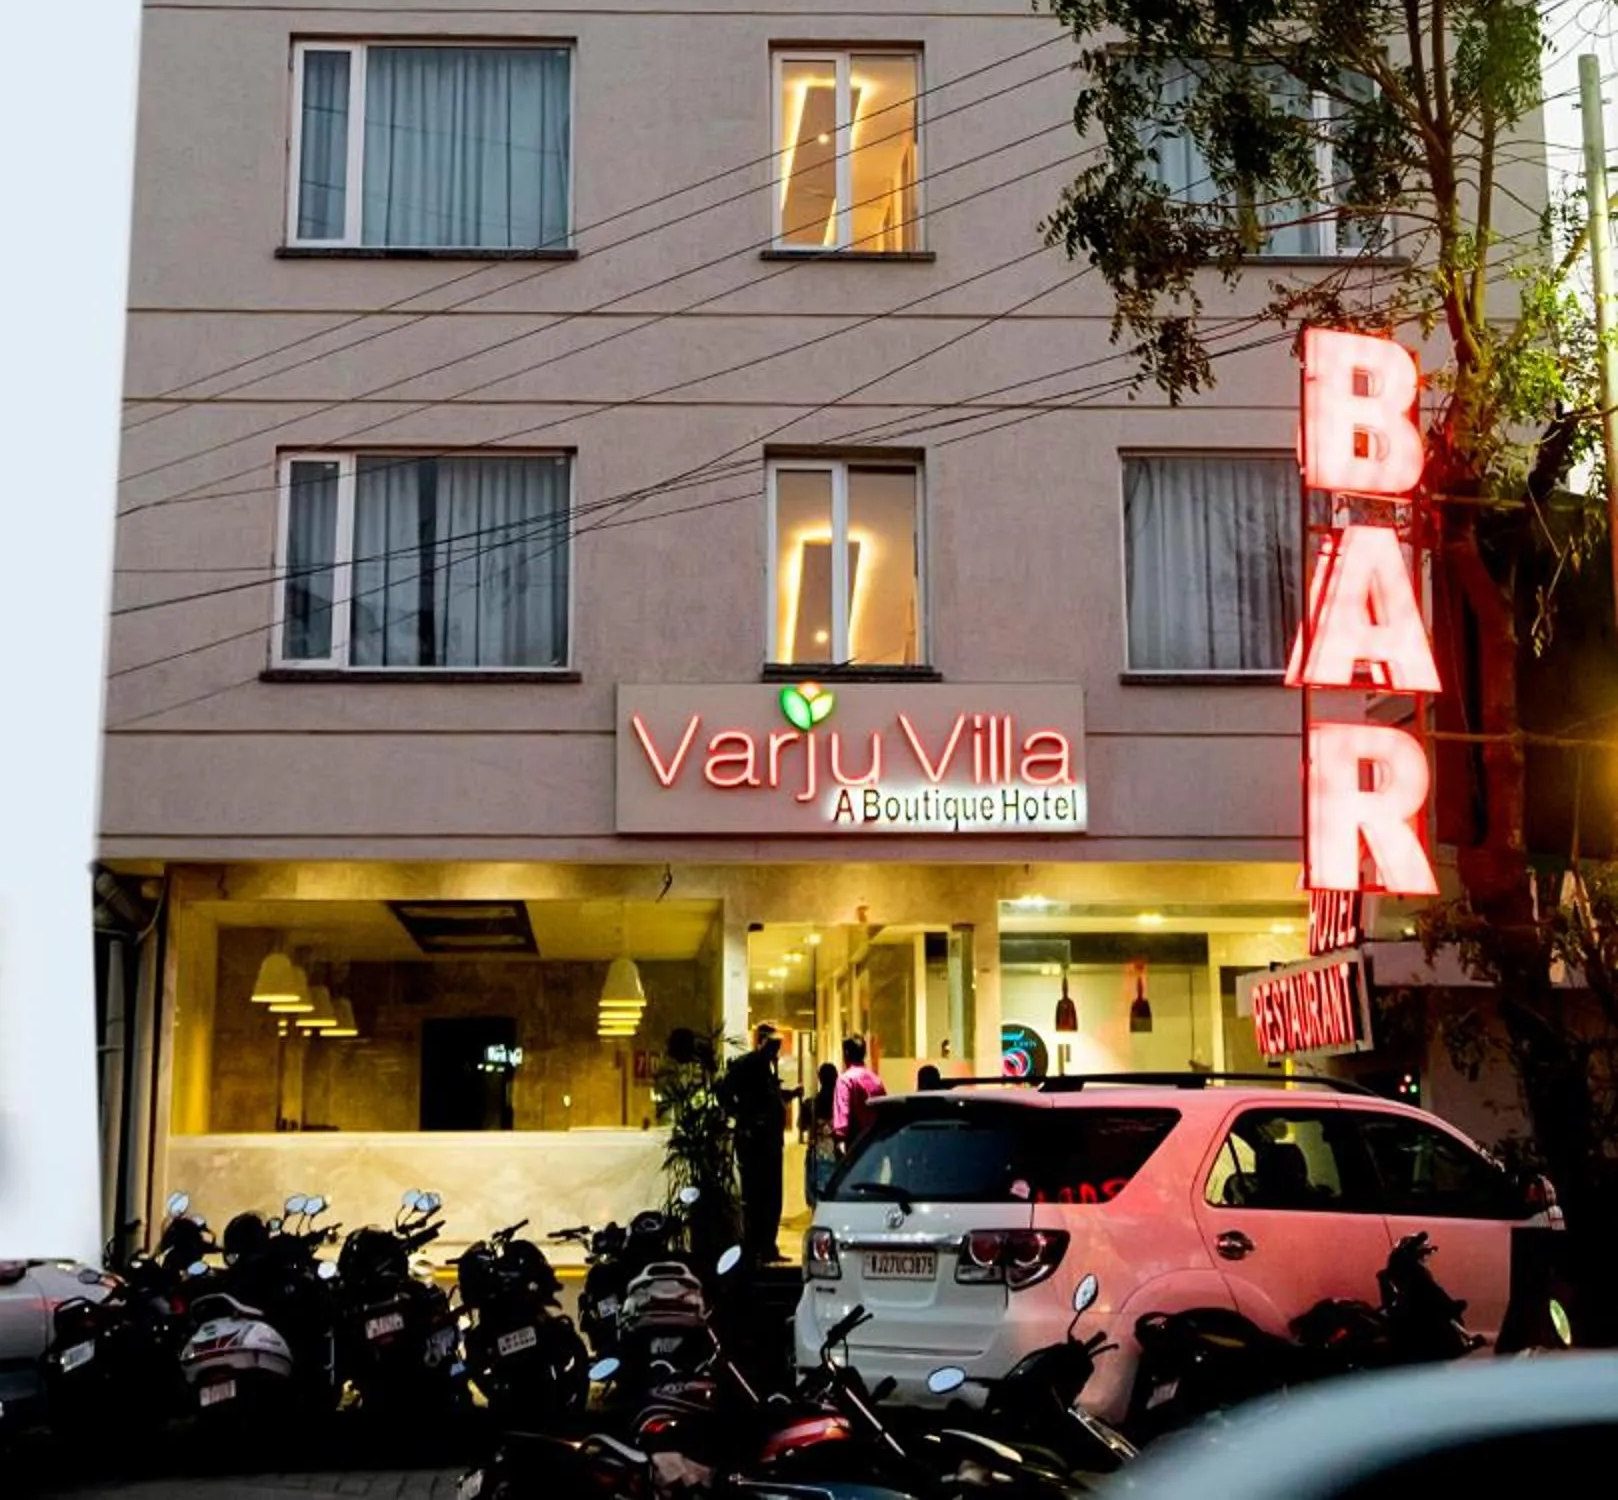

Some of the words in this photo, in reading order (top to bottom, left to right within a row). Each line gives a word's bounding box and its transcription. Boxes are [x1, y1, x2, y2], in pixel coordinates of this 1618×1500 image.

[1303, 326, 1442, 896] BAR
[632, 713, 882, 802] Varju
[898, 713, 1076, 787] Villa
[833, 789, 857, 823] A
[862, 789, 996, 830] Boutique
[1001, 789, 1080, 823] Hotel
[1309, 889, 1357, 956] HOTEL
[1252, 961, 1356, 1057] RESTAURANT
